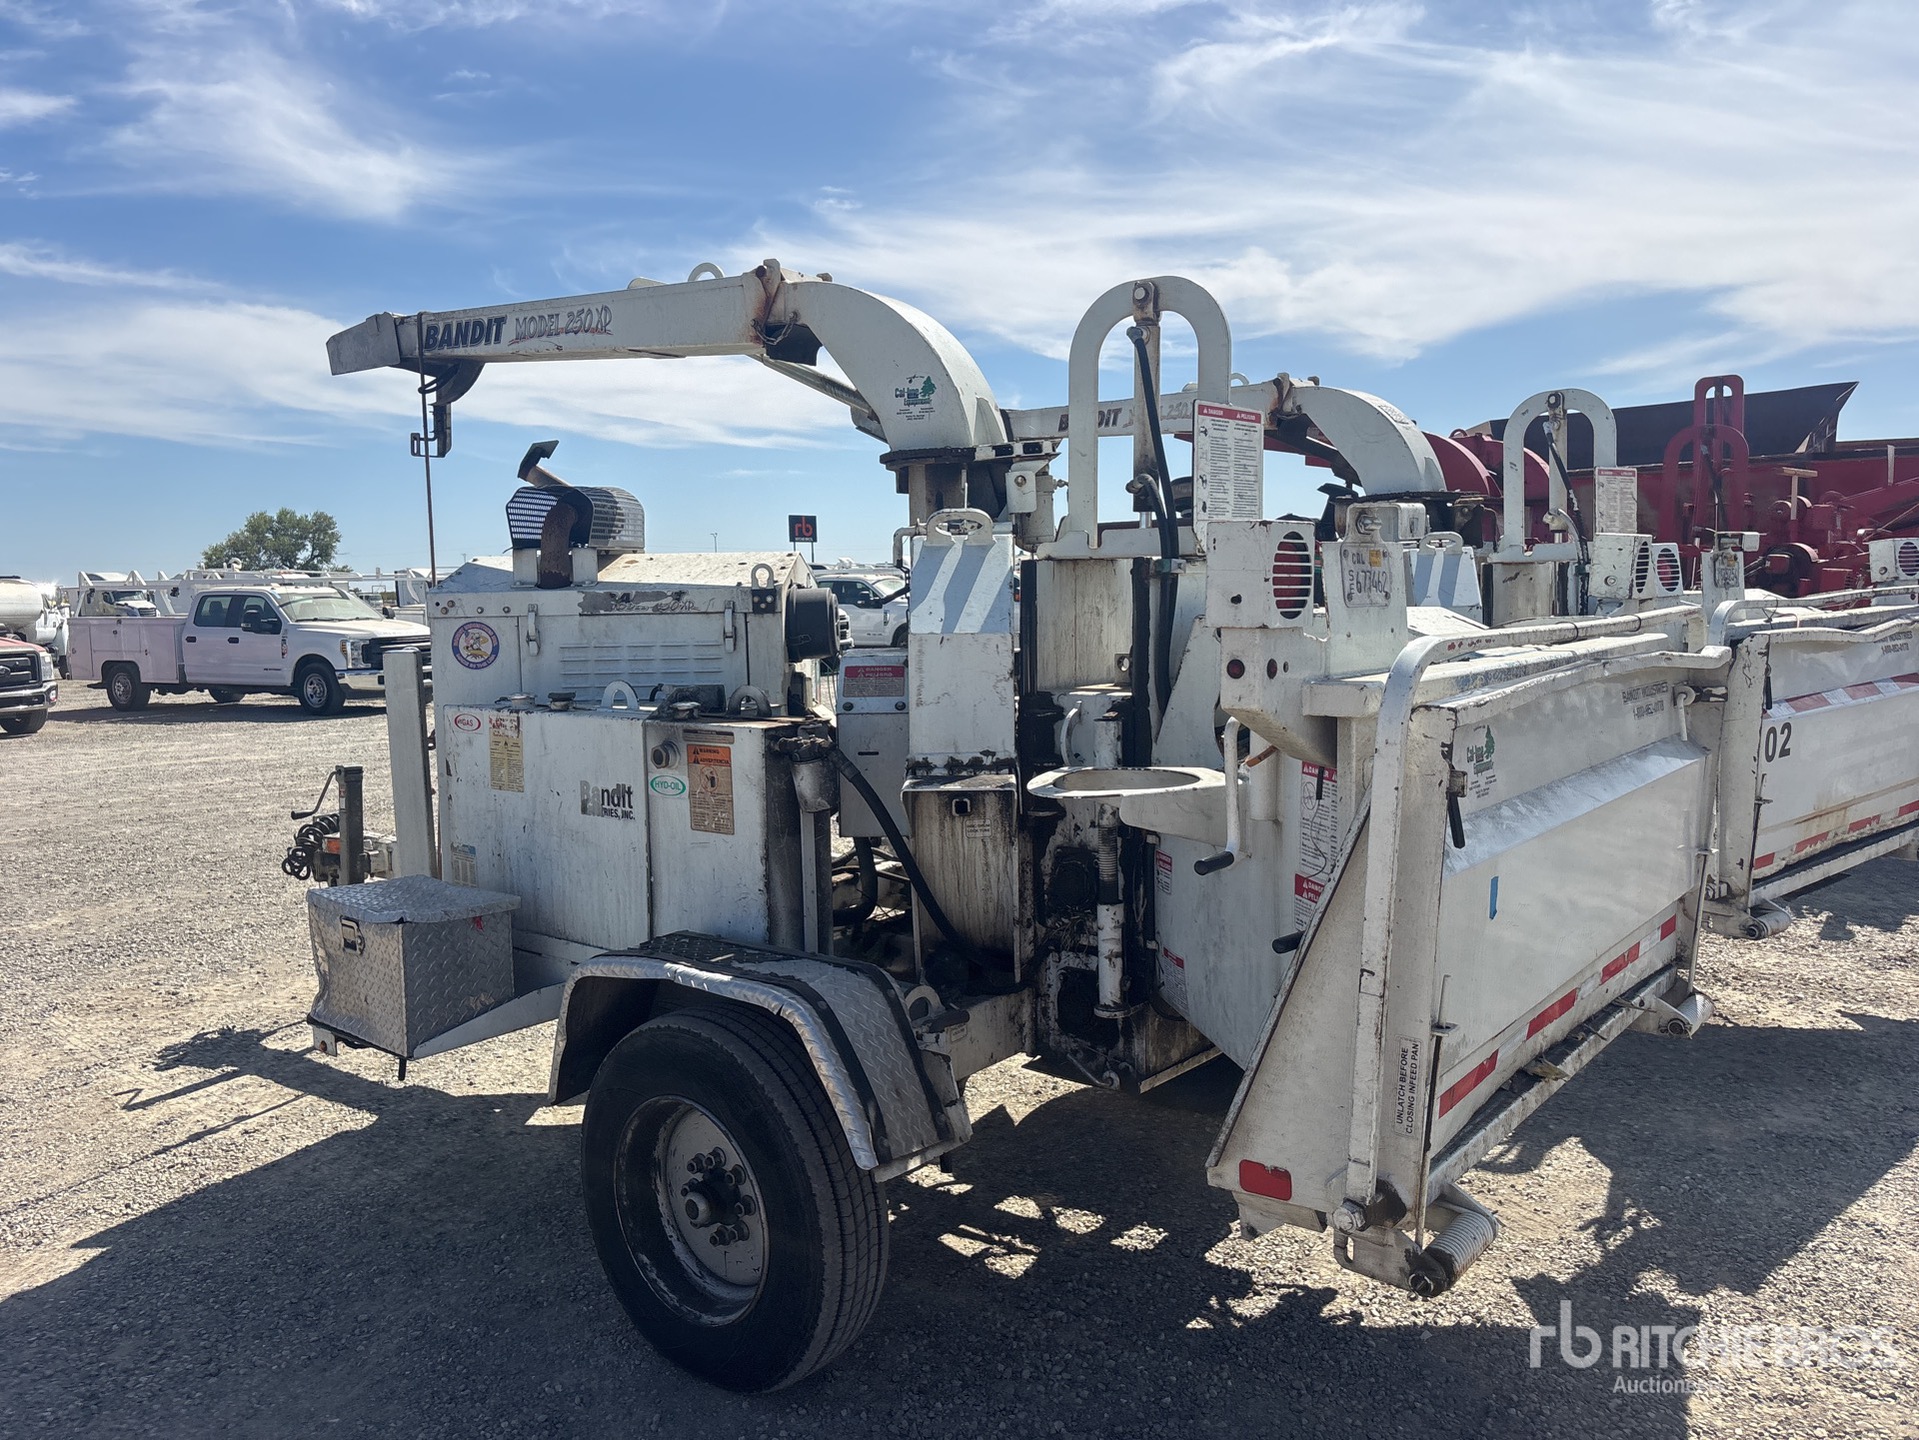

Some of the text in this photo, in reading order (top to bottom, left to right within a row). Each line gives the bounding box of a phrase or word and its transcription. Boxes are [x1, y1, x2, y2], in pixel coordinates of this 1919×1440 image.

[424, 315, 508, 351] BANDIT
[515, 313, 561, 340] MODEL
[1058, 407, 1122, 432] BDIT
[795, 515, 813, 537] rb
[1765, 722, 1792, 763] 02
[654, 781, 681, 791] HYD-OIL
[1396, 1047, 1408, 1124] UNLATCH BEFORE
[1406, 1042, 1419, 1134] CLOSING INFEED PAN
